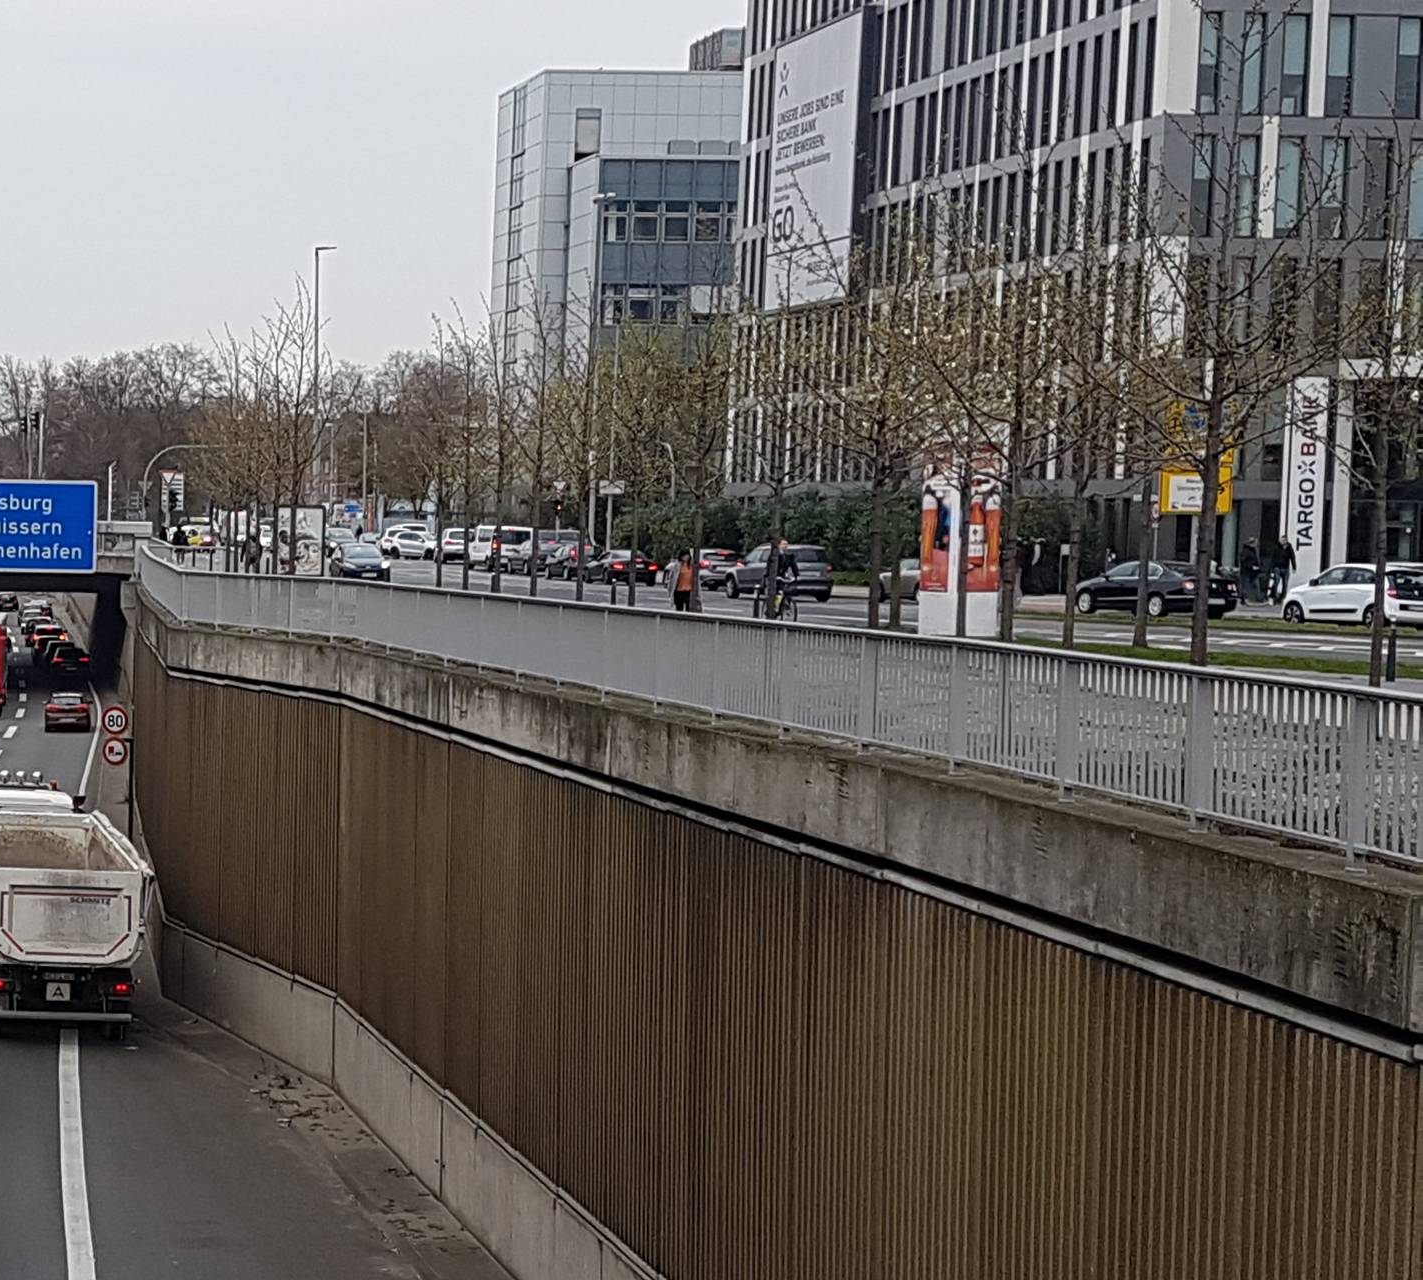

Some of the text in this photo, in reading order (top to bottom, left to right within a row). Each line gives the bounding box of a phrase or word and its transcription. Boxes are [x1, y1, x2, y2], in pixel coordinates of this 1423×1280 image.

[773, 205, 794, 243] GO
[107, 714, 123, 728] 80
[52, 986, 64, 998] A
